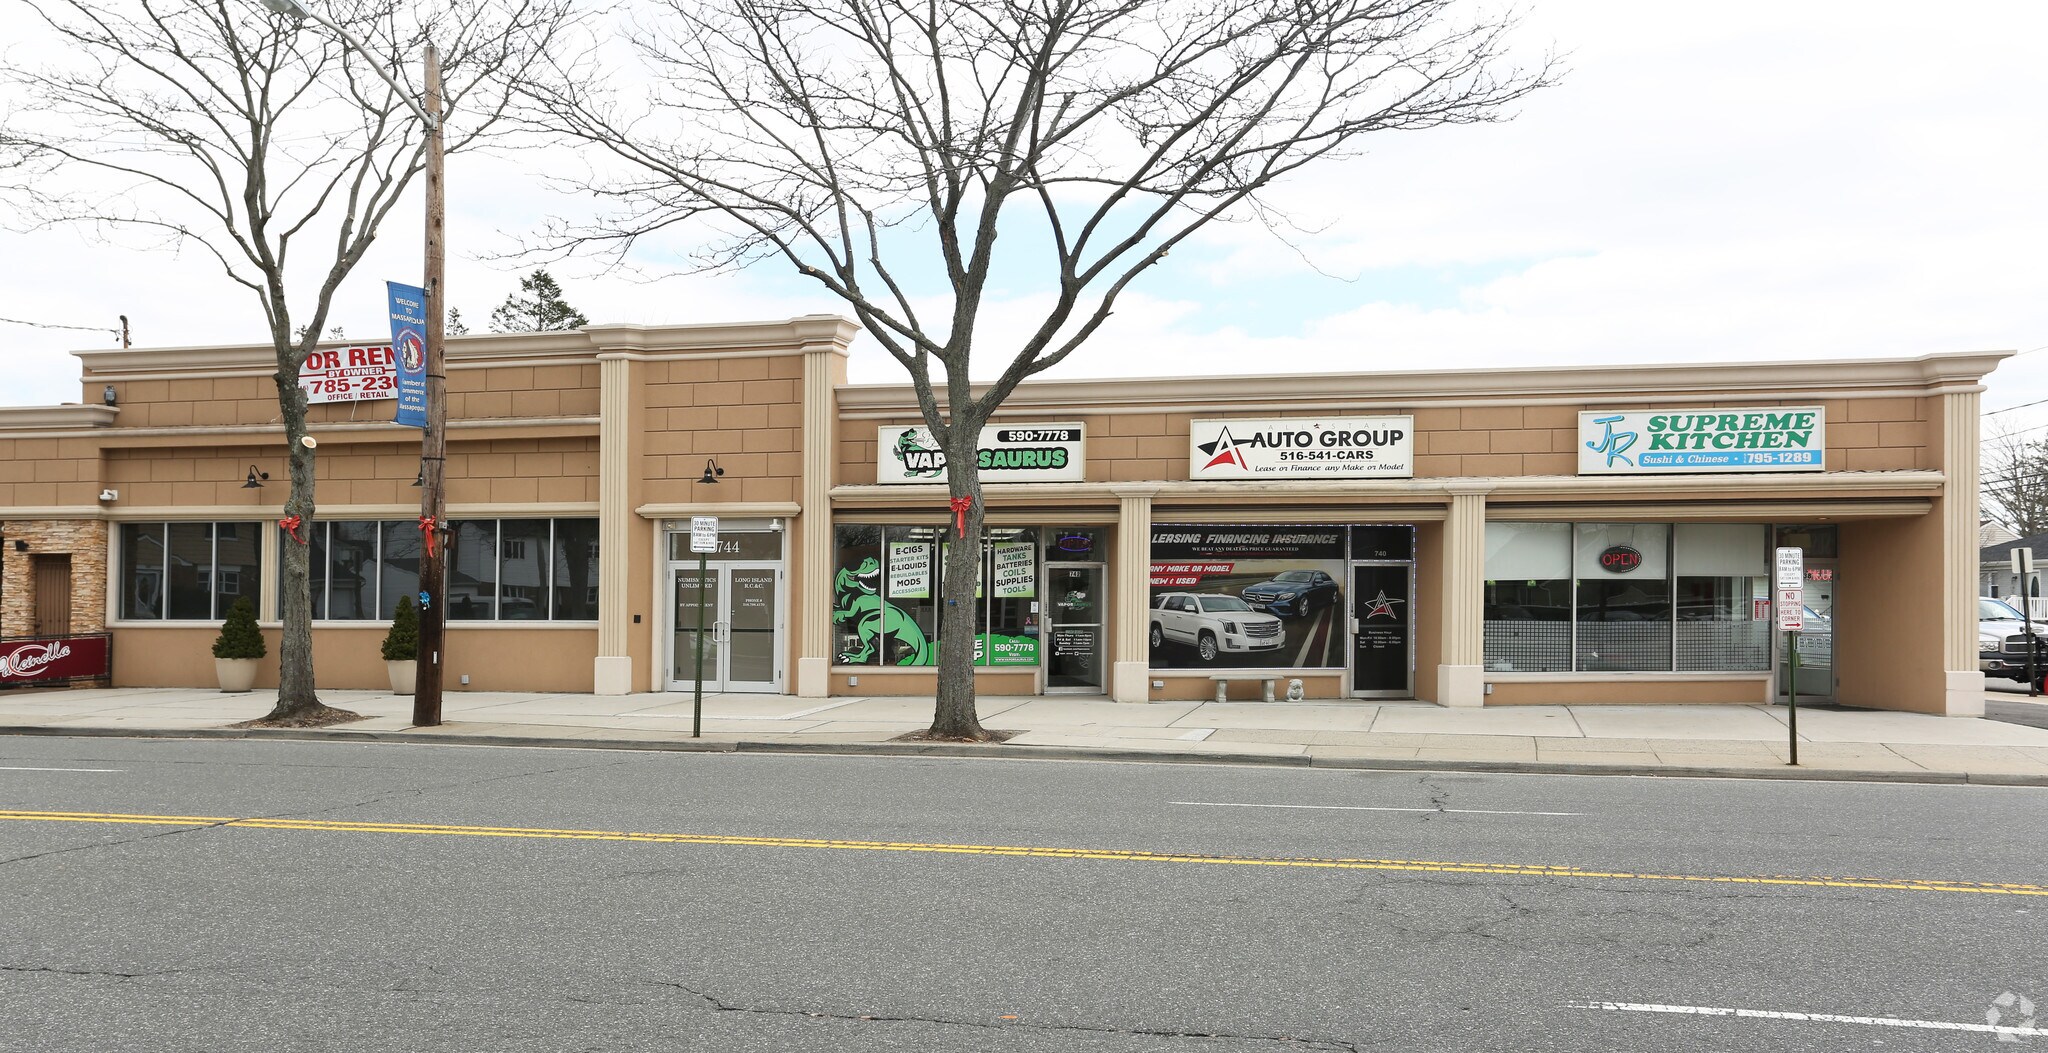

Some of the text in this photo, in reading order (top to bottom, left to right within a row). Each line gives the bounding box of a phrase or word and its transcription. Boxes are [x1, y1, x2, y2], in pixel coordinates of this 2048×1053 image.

[395, 297, 419, 309] WELCOME
[306, 351, 341, 370] OR
[349, 347, 396, 367] REN
[343, 367, 384, 377] OWNER
[327, 392, 353, 401] OFFICE
[360, 391, 389, 399] RETAIL
[1647, 412, 1816, 433] SUPREME
[1008, 430, 1069, 441] 590-7778
[1250, 429, 1404, 449] AUTO GROUP
[1648, 430, 1814, 450] KITCHEN
[1280, 450, 1374, 461] 516-541-CARS
[1643, 454, 1673, 465] Sushi
[1675, 454, 1684, 464] &
[1687, 453, 1729, 464] Chinese
[1747, 452, 1812, 464] 795-1289
[1255, 464, 1277, 472] Lease
[1290, 464, 1321, 472] Finance
[1324, 465, 1340, 473] any
[1342, 463, 1365, 471] Make
[1378, 463, 1404, 471] Model
[1151, 533, 1339, 544] LEASING FINANCING INSURANCE
[717, 540, 740, 553] 744
[896, 545, 923, 555] E-CIGS
[997, 545, 1032, 555] HARDWARE
[890, 556, 915, 564] STARTER
[1003, 552, 1027, 562] TANKS
[1602, 553, 1638, 566] OPEN
[891, 562, 927, 572] E-LIQUIDS
[996, 559, 1032, 570] BATTERIES
[1150, 565, 1230, 573] ANY MAKE OR MODEL
[890, 570, 928, 579] REBUILDABLES
[1003, 568, 1027, 577] COILS
[896, 577, 921, 587] MODS
[996, 575, 1034, 587] SUPPLIES
[1150, 577, 1168, 585] NEW
[1175, 577, 1197, 585] USED
[892, 587, 926, 595] ACCESSORIES
[1003, 585, 1027, 594] TOOLS
[1785, 592, 1795, 600] NO
[994, 643, 1034, 651] 590-7778
